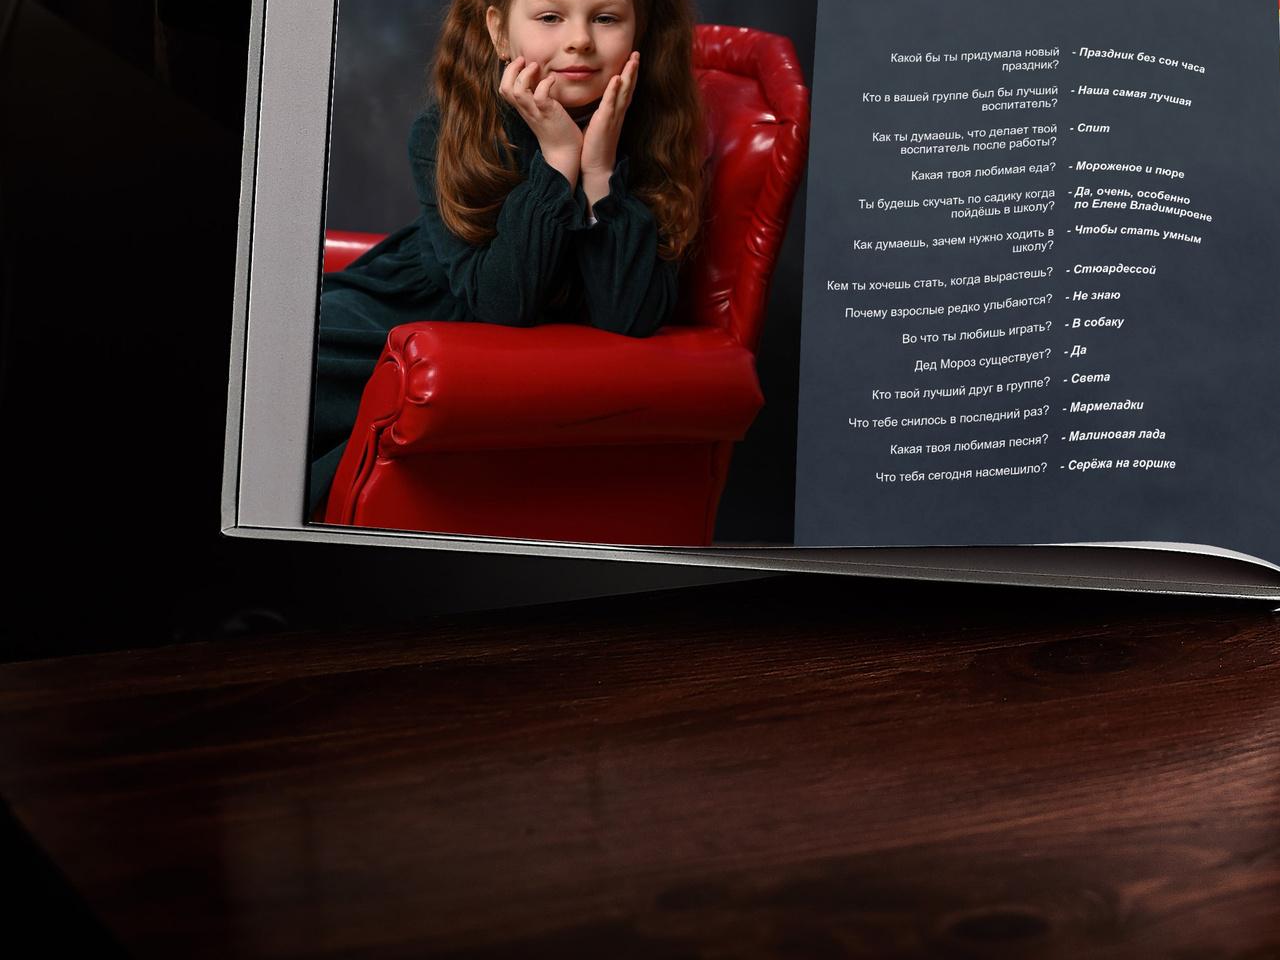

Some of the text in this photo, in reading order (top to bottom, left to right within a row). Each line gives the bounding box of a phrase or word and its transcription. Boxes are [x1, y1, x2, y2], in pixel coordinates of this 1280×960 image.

[891, 53, 922, 62] Какой
[926, 53, 940, 62] бы
[961, 50, 1021, 62] придумала
[1025, 47, 1059, 56] новый
[1080, 47, 1134, 60] Праздник
[1137, 53, 1156, 63] без
[1159, 58, 1178, 67] сон
[1182, 62, 1205, 73] часа
[1002, 60, 1059, 72] праздник?
[863, 93, 881, 102] Кто
[894, 92, 928, 102] вашей
[932, 92, 968, 103] группе
[972, 89, 994, 98] был
[998, 88, 1012, 97] бы
[1016, 86, 1058, 97] лучший
[1078, 86, 1109, 95] Наша
[1113, 89, 1147, 98] самая
[1149, 93, 1192, 106] лучшая
[982, 98, 1058, 111] воспитатель?
[873, 132, 890, 142] Как
[910, 132, 963, 142] думаешь,
[989, 127, 1029, 138] делает
[1032, 124, 1057, 133] твой
[1078, 123, 1110, 132] Спит
[901, 136, 1056, 154] воспитатель после работы?
[912, 162, 1056, 180] Какая твоя любимая еда?
[1076, 161, 1142, 172] Мороженое
[1155, 168, 1184, 178] пюре
[859, 199, 874, 209] Ты
[878, 199, 919, 210] будешь
[923, 198, 964, 208] скучать
[984, 192, 1022, 203] садику
[1026, 190, 1055, 199] когда
[1074, 186, 1093, 198] Да,
[1097, 189, 1133, 198] очень,
[1137, 191, 1190, 204] особенно
[951, 207, 1000, 218] пойдёшь
[1014, 201, 1055, 213] школу?
[1092, 199, 1126, 209] Елене
[1130, 200, 1212, 222] Владимировне
[854, 240, 872, 250] Как
[875, 240, 928, 251] думаешь,
[932, 237, 965, 246] зачем
[969, 234, 1003, 245] нужно
[1006, 230, 1044, 240] ходить
[1075, 224, 1117, 234] Чтобы
[1120, 227, 1160, 236] стать
[1162, 231, 1201, 244] умным
[1013, 240, 1054, 252] школу?
[1074, 263, 1156, 275] Стюардессой
[828, 281, 848, 290] Кем
[869, 282, 910, 290] хочешь
[914, 279, 946, 288] стать,
[951, 276, 980, 286] когда
[984, 267, 1053, 283] вырастешь?
[1073, 291, 1089, 301] Не
[1091, 292, 1120, 300] знаю
[846, 294, 1052, 319] Почему взрослые редко улыбаются?
[1072, 318, 1081, 328] В
[1084, 316, 1124, 328] собаку
[903, 321, 1052, 344] Во что ты любишь играть?
[914, 348, 1051, 372] Дед Мороз существует?
[1070, 345, 1086, 358] Да
[872, 376, 1050, 399] Кто твой лучший друг в группе?
[1072, 374, 1110, 383] Света
[1070, 399, 1144, 413] Мармеладки
[849, 405, 1049, 427] Что тебе снилось в последний раз?
[891, 434, 1048, 454] Какая твоя любимая песня?
[1069, 431, 1136, 441] Малиновая
[1138, 429, 1166, 439] лада
[876, 462, 1047, 482] Что тебя сегодня насмешило?
[1068, 458, 1112, 472] Серёжа
[1116, 460, 1130, 468] на
[1133, 460, 1176, 470] горшке
